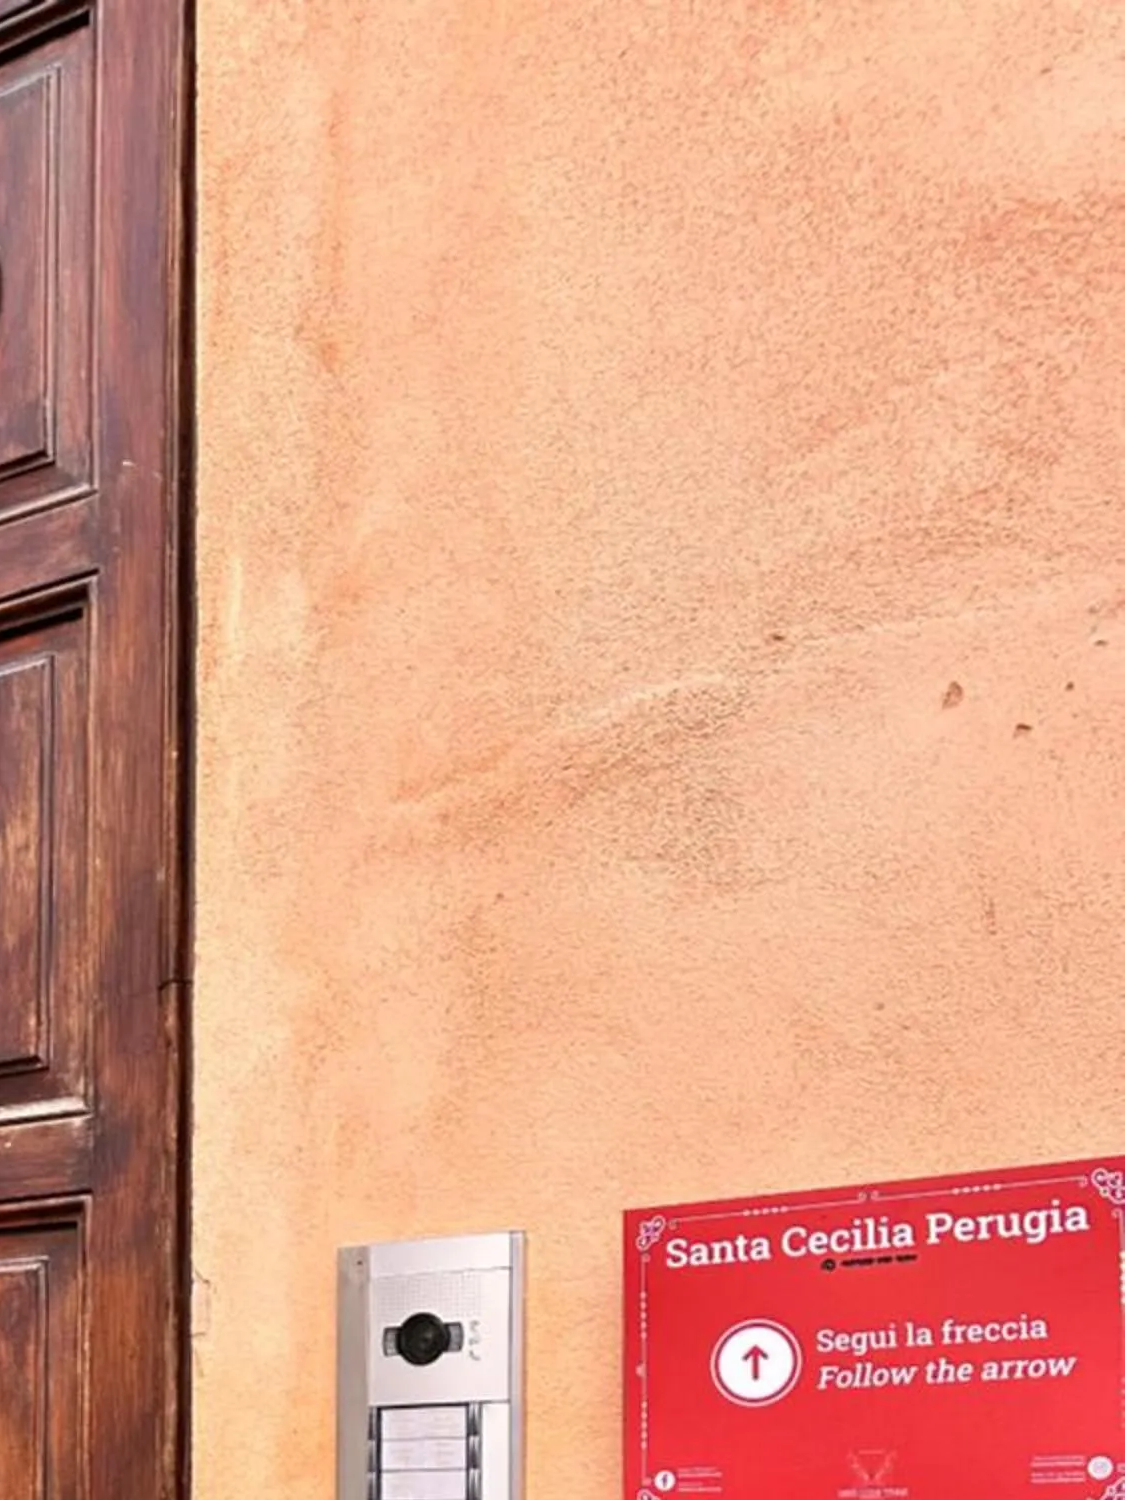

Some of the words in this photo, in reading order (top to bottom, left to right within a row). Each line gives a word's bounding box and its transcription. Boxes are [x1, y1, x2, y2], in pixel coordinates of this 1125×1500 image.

[666, 1235, 771, 1268] Santa
[781, 1213, 914, 1258] Cecilia
[926, 1199, 1089, 1246] Perugia
[816, 1324, 896, 1356] Segui
[906, 1322, 932, 1347] la
[941, 1314, 1048, 1344] freccia
[817, 1362, 916, 1389] Follow
[925, 1357, 973, 1384] the
[980, 1356, 1077, 1381] arrow
